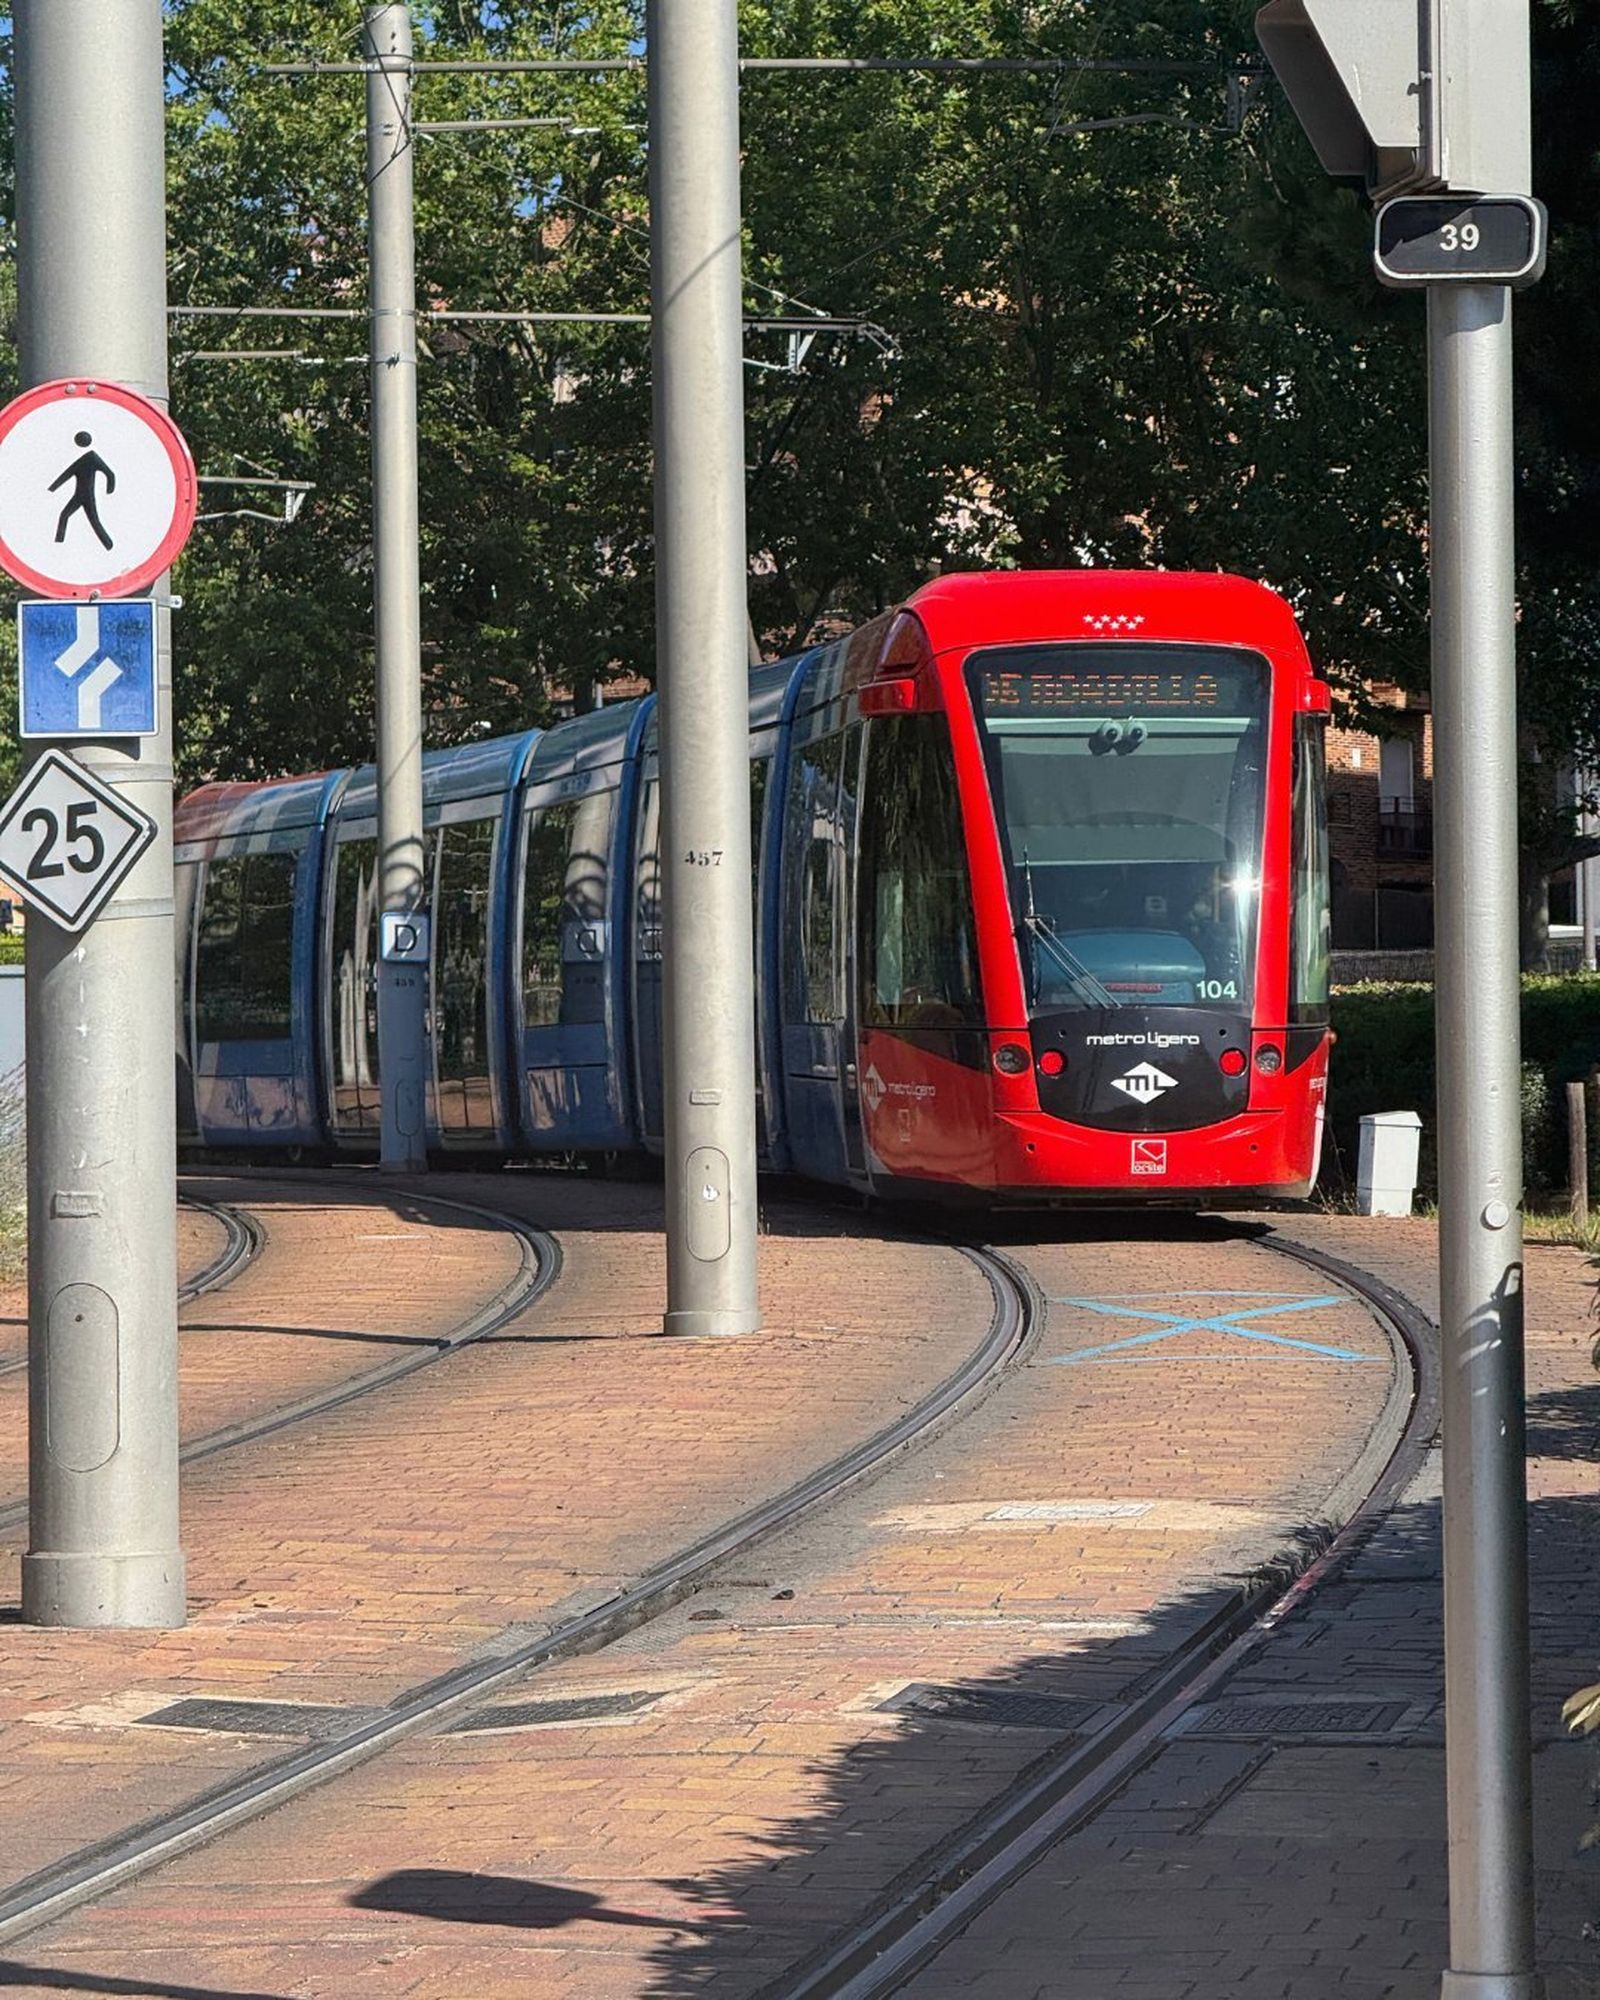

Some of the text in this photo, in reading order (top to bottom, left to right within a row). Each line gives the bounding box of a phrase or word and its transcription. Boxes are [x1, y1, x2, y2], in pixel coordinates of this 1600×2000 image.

[1439, 223, 1480, 251] 39
[20, 801, 105, 881] 25
[684, 850, 724, 866] 457
[394, 923, 417, 952] D
[1196, 980, 1238, 999] 104
